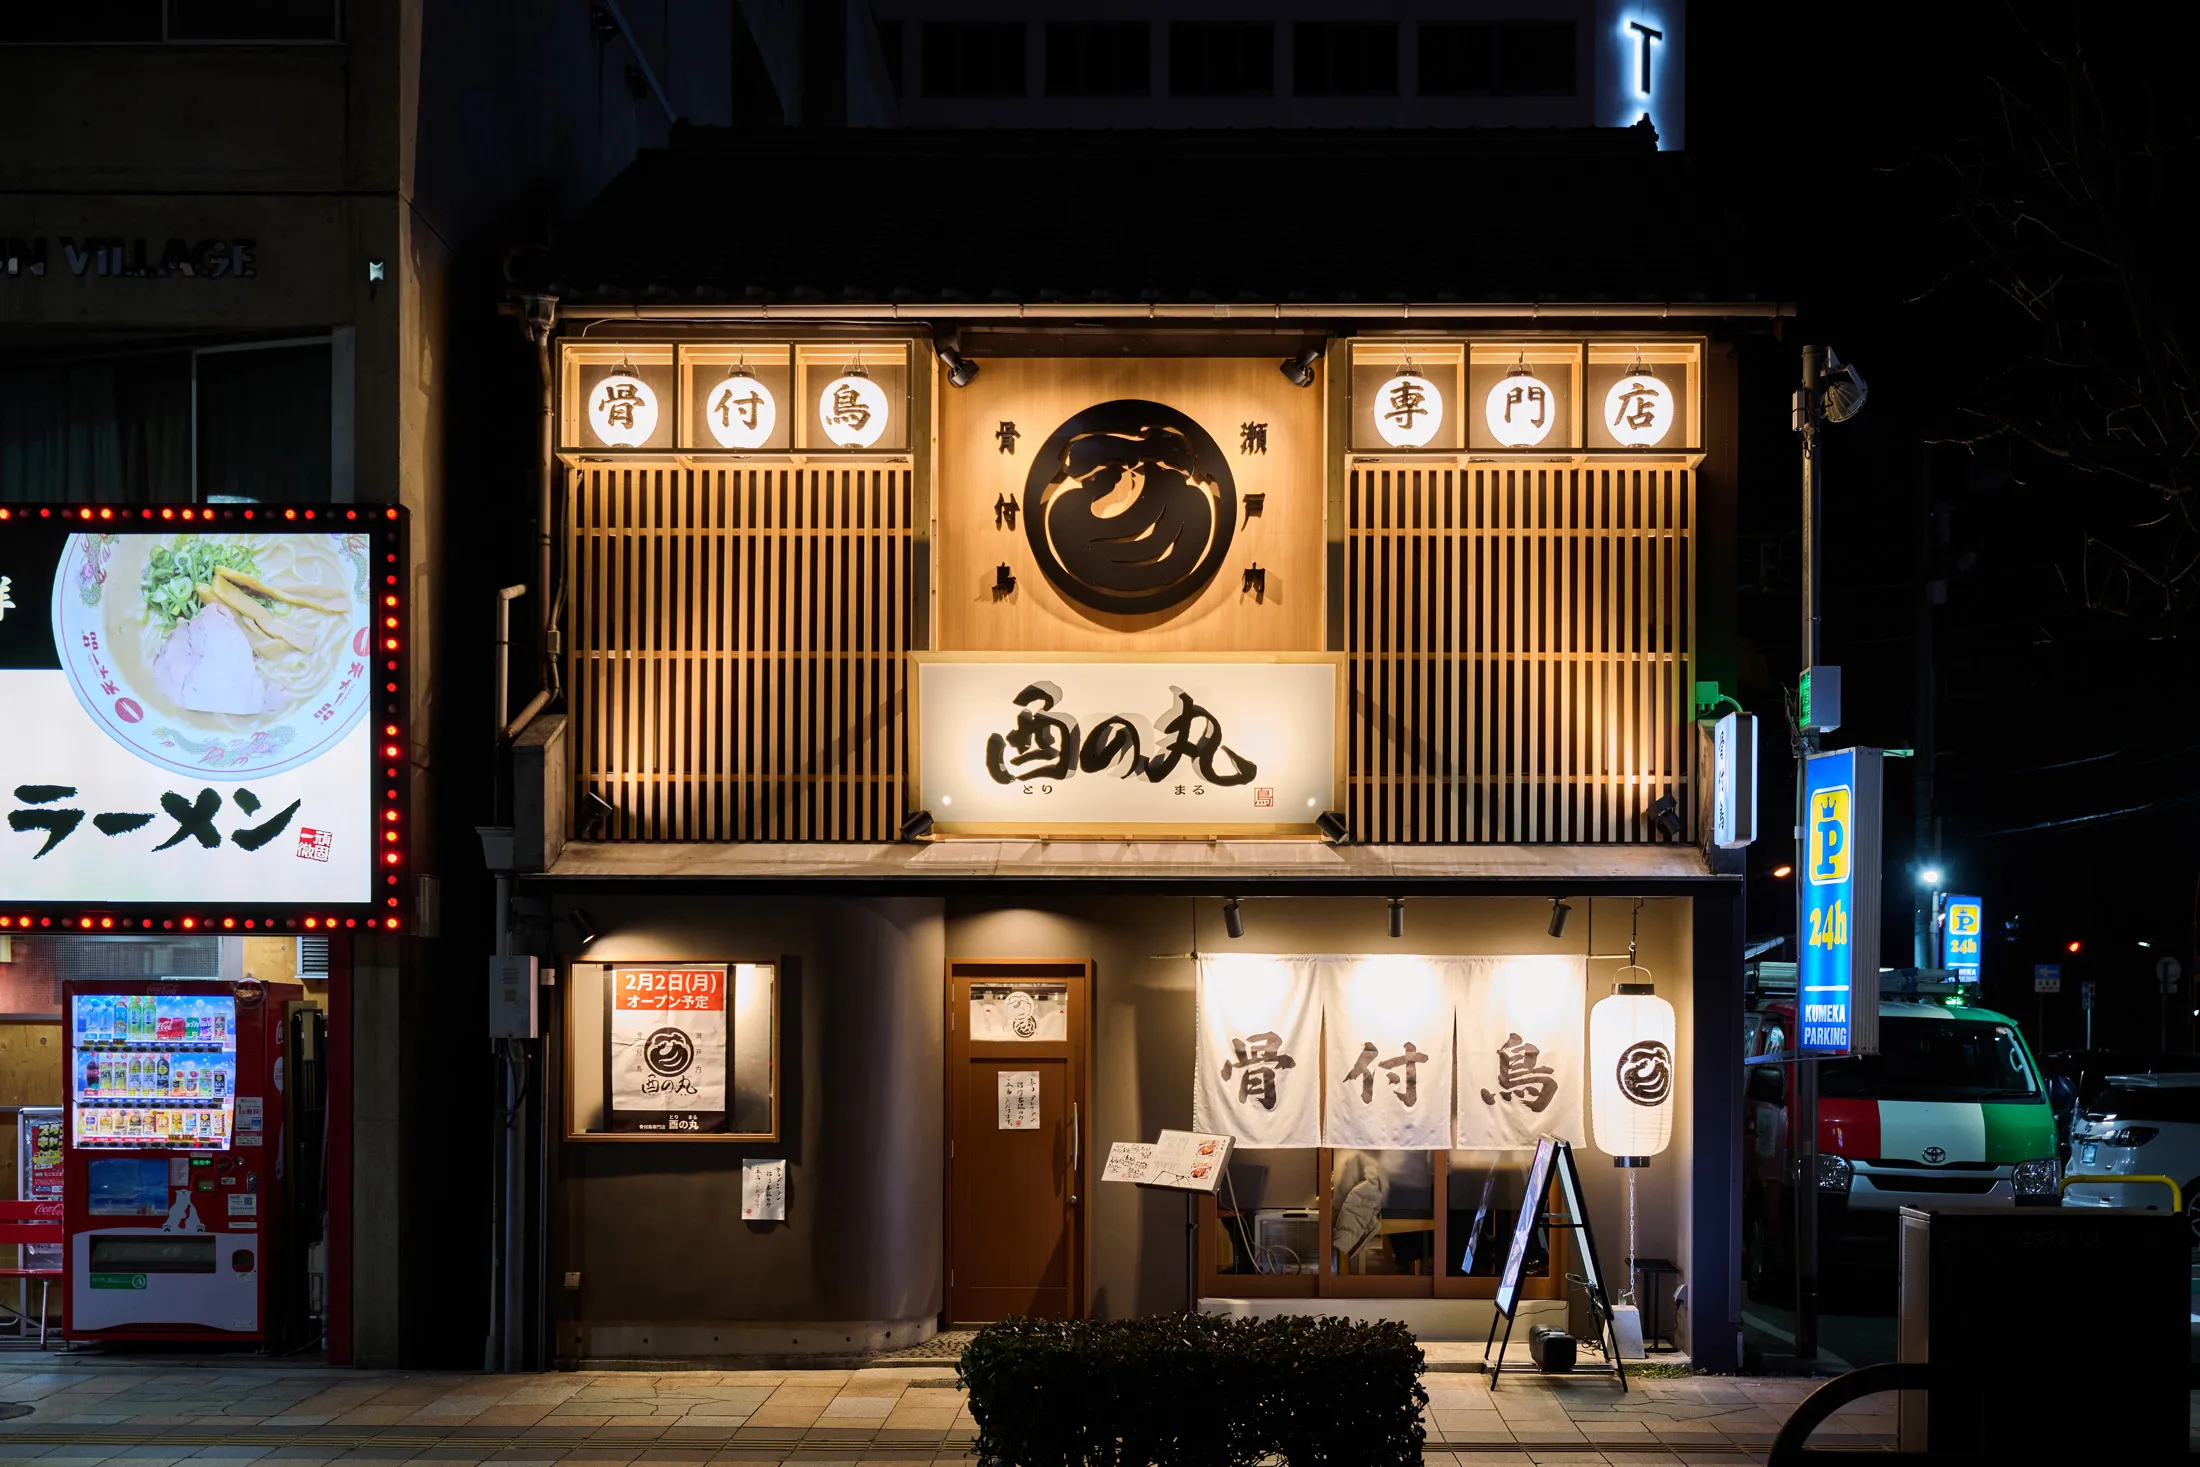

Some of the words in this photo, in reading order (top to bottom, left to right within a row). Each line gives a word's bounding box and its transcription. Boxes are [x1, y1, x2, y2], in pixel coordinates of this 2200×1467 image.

[1630, 21, 1662, 94] T
[0, 237, 47, 276] N
[59, 237, 258, 277] VILLAGE
[985, 683, 1258, 787] 酉の丸
[1022, 784, 1053, 796] とり
[1174, 784, 1206, 796] まる
[7, 784, 302, 860] ラーメン
[1808, 899, 1848, 950] 24h
[1950, 938, 1977, 954] 24h
[625, 973, 717, 993] 2月2日(月)
[627, 994, 709, 1009] オープン予定
[1805, 1004, 1846, 1023] KUMEKA
[1804, 1027, 1847, 1046] PARKING
